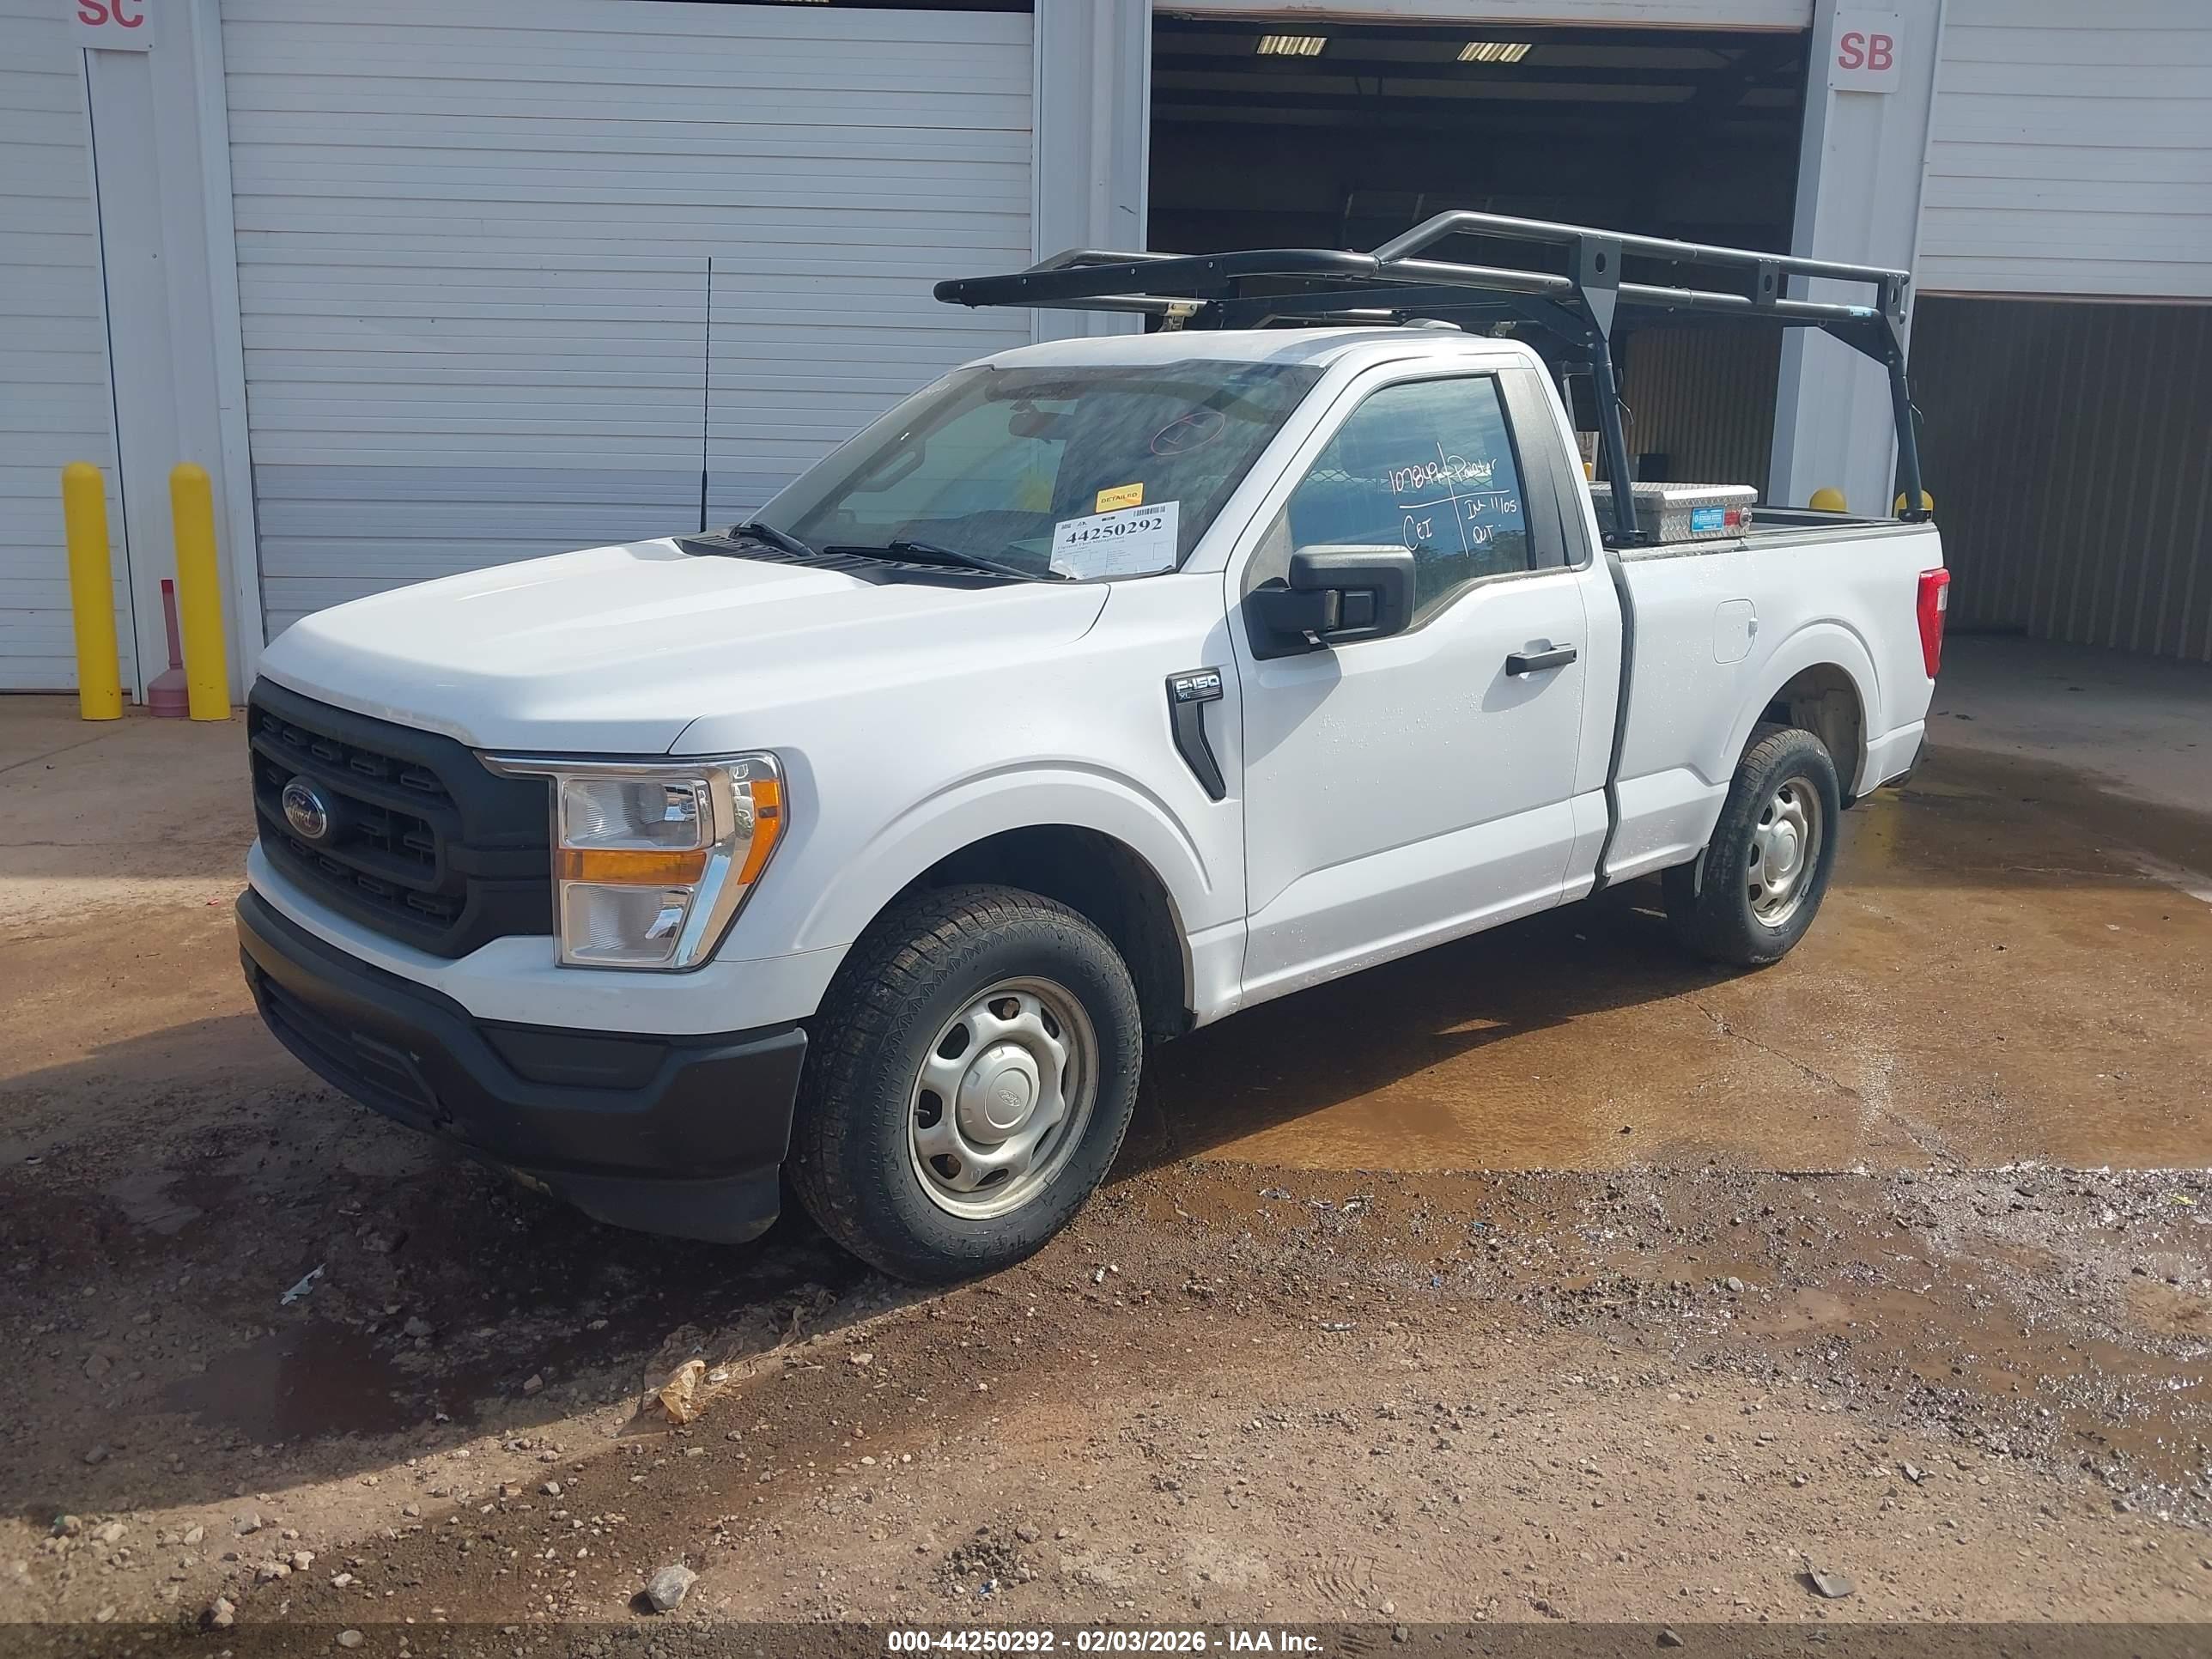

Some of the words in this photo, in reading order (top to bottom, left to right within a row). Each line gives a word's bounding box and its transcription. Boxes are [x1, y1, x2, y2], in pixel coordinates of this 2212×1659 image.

[77, 0, 144, 28] SC
[1838, 32, 1894, 70] SB
[1101, 493, 1138, 503] DETAILED
[1066, 518, 1162, 544] 44250292
[1176, 675, 1219, 692] F-150
[287, 793, 313, 828] Ford
